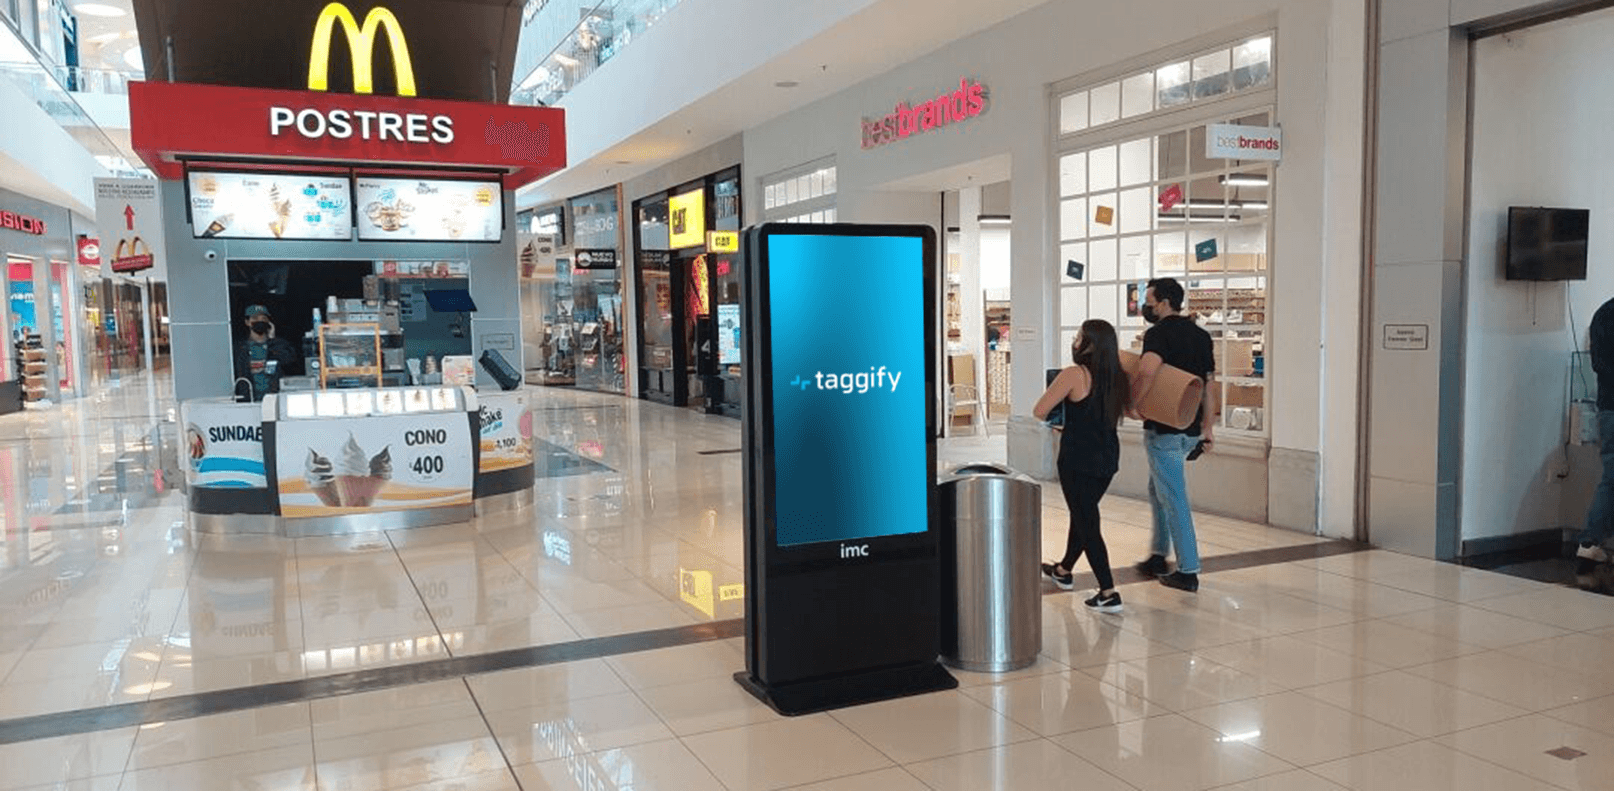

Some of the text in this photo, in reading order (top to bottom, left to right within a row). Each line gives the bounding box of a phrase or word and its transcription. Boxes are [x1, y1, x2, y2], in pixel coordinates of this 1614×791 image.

[270, 106, 455, 144] POSTRES
[0, 210, 47, 235] SION
[815, 365, 902, 394] taggify
[208, 425, 263, 443] SUNDAE
[405, 429, 447, 446] CONO
[840, 543, 870, 559] imc
